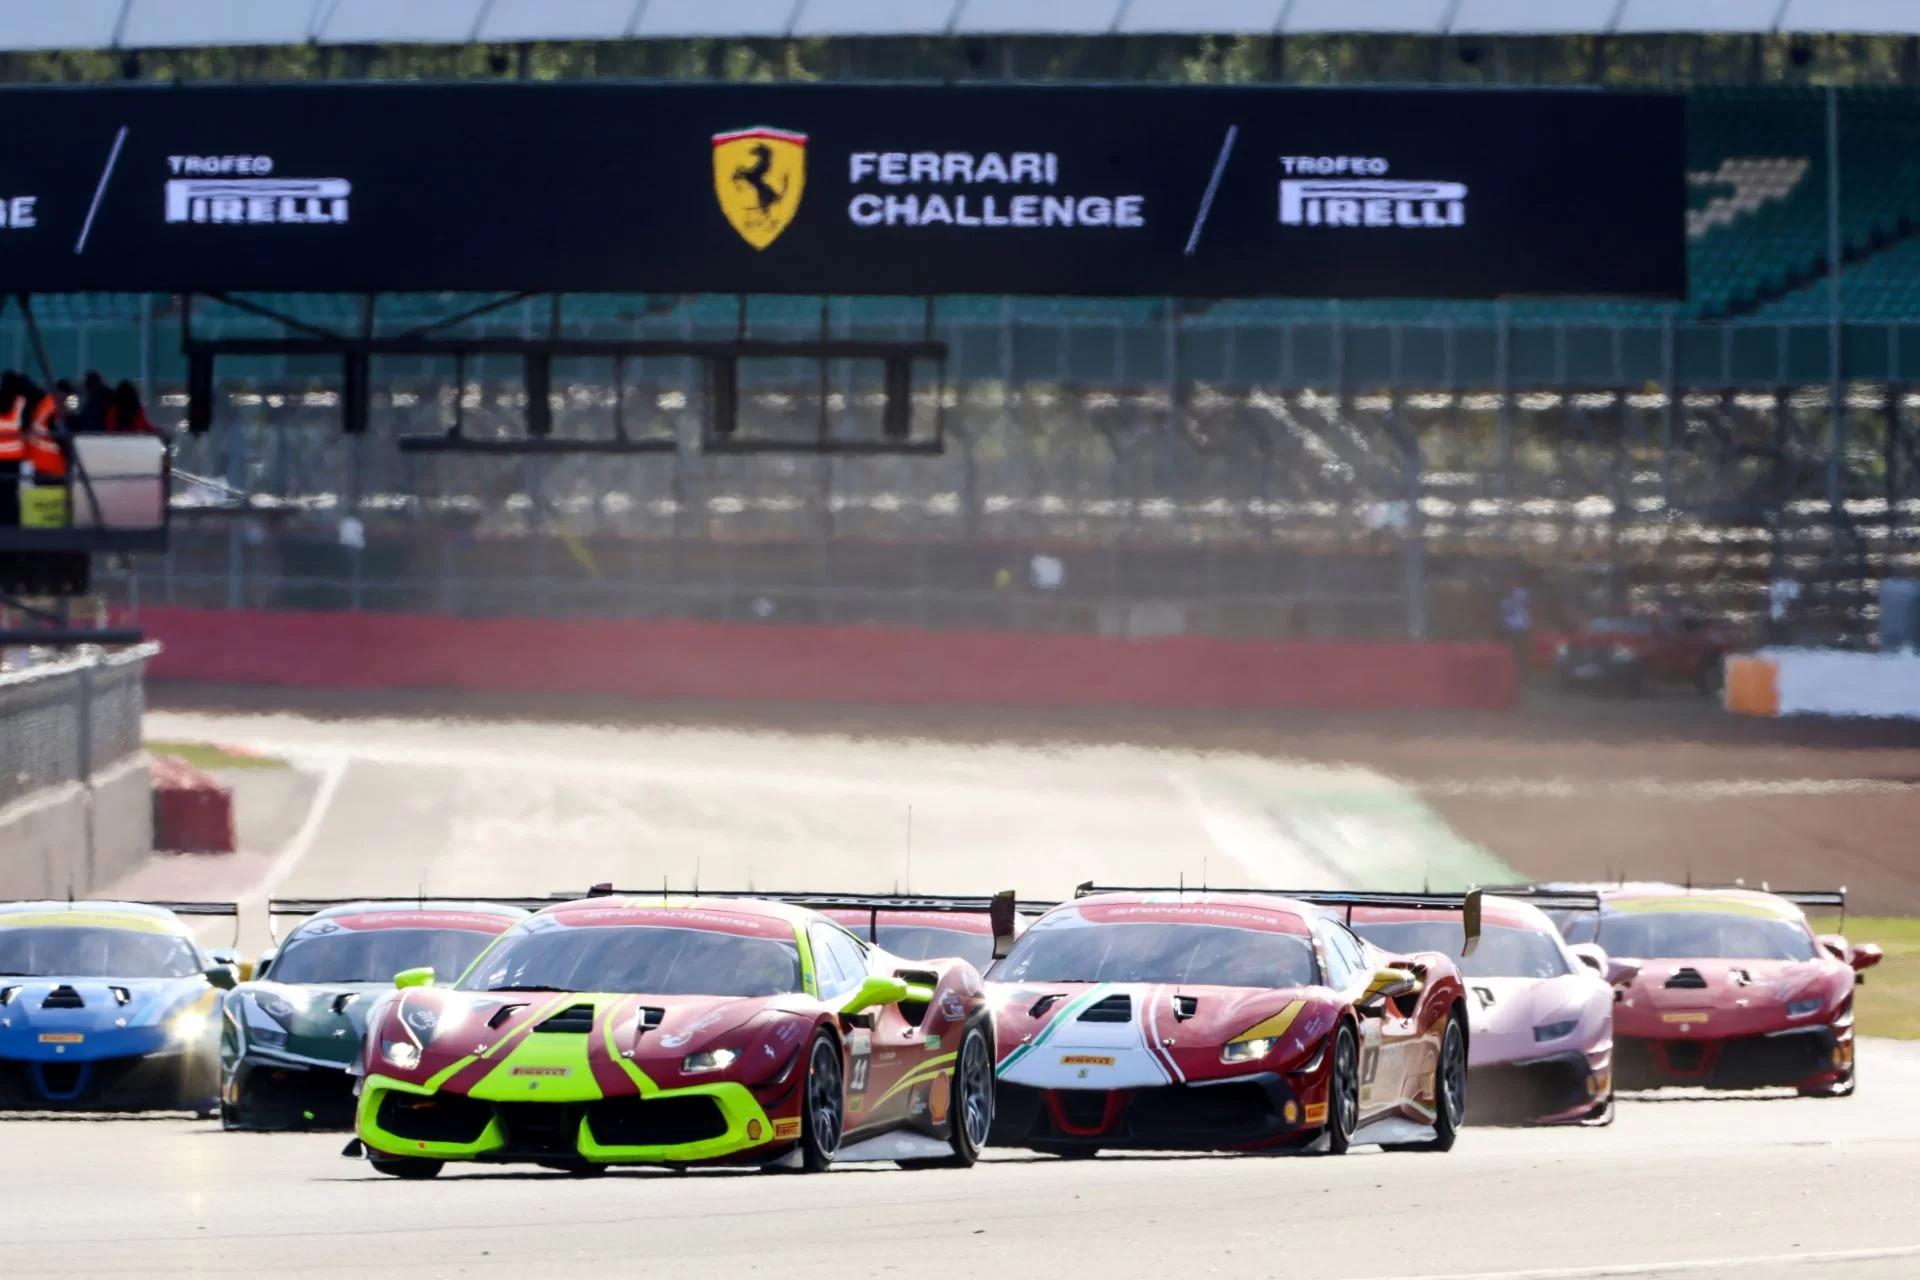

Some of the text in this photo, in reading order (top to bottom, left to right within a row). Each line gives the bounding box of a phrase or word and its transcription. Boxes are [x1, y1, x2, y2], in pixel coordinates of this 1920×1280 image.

[168, 155, 273, 173] TROFEO
[849, 152, 1058, 185] FERRARI
[1280, 156, 1389, 175] TROFEO
[0, 196, 37, 228] E
[164, 177, 352, 224] PIRELLI
[848, 194, 1145, 228] CHALLENGE
[1279, 180, 1468, 228] PIRELLI
[850, 1058, 868, 1090] 11
